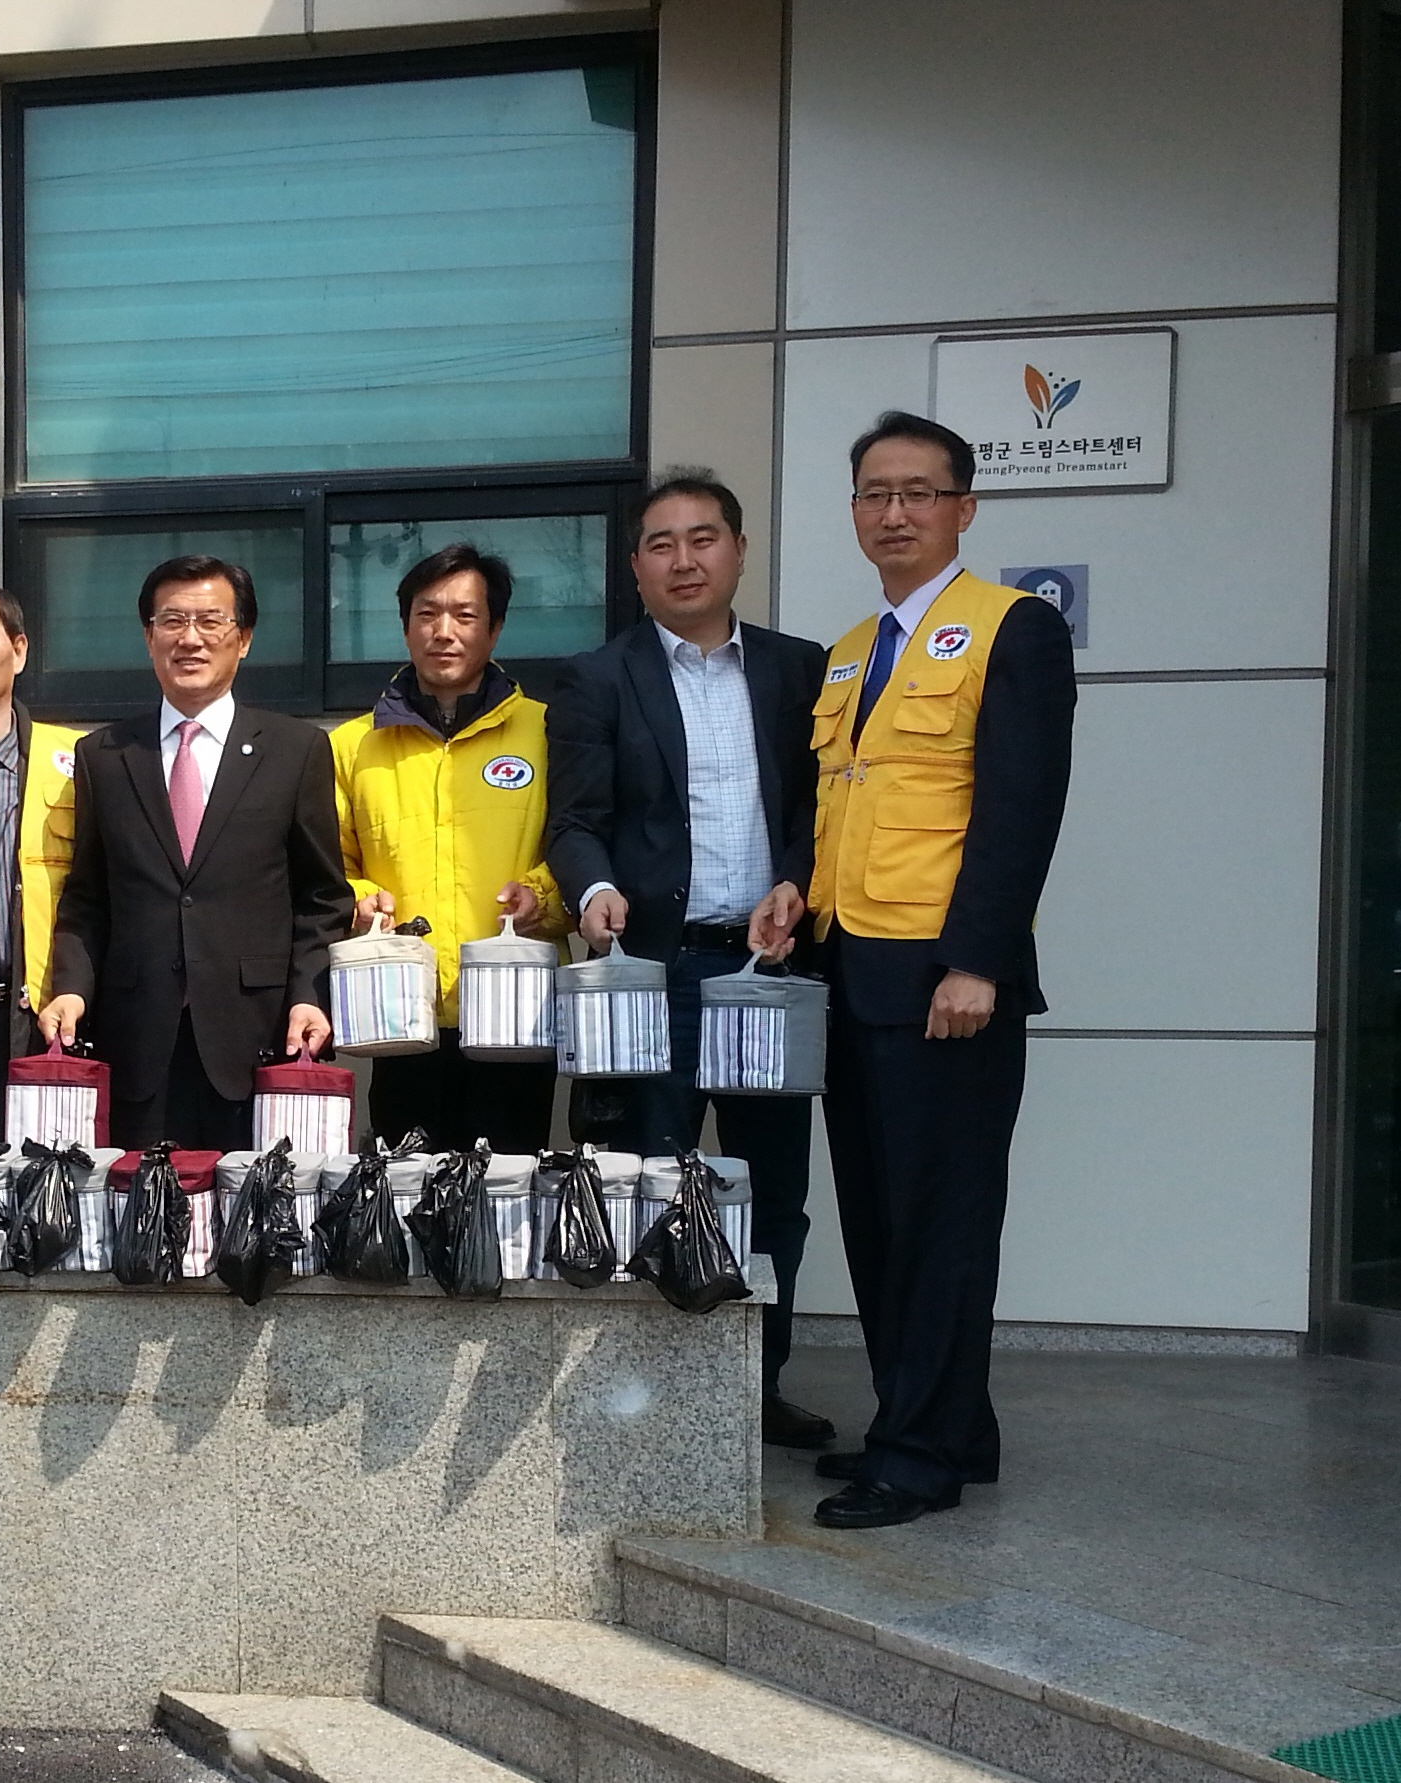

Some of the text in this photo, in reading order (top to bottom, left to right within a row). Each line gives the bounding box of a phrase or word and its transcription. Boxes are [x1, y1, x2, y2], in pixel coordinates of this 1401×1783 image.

[1020, 436, 1142, 459] 드림스타트센터
[974, 461, 1128, 476] eungPyeong Dreamstart
